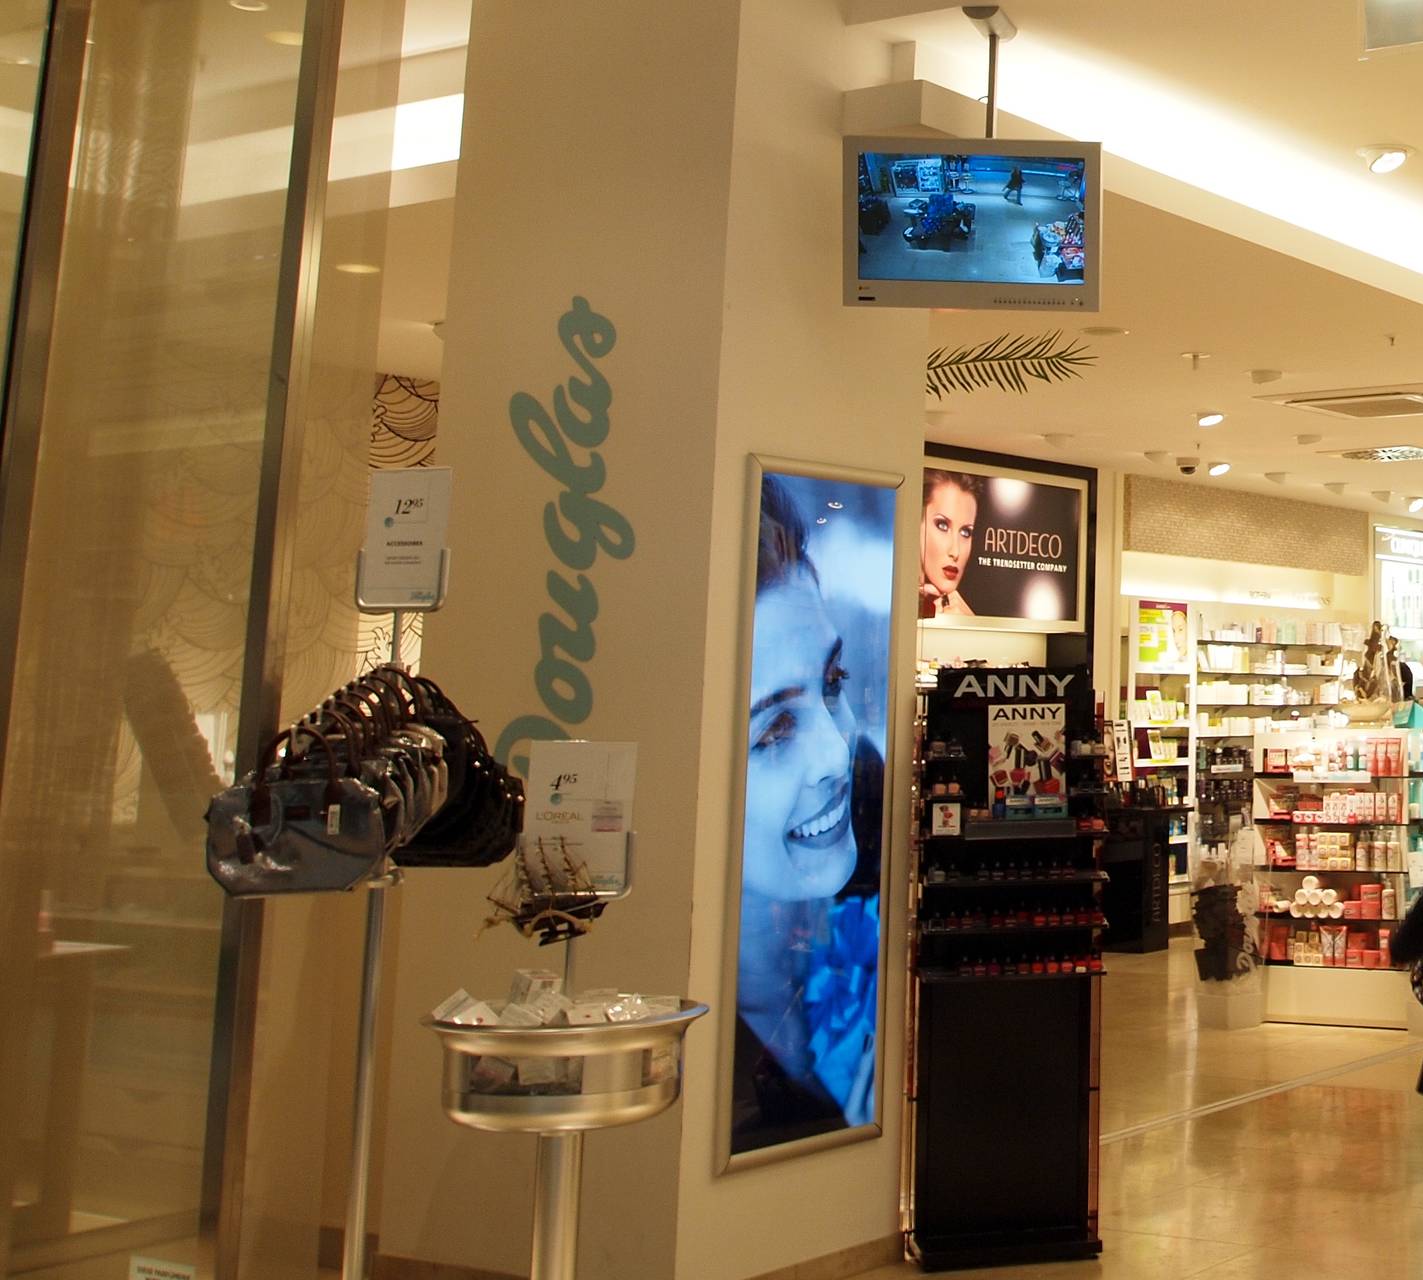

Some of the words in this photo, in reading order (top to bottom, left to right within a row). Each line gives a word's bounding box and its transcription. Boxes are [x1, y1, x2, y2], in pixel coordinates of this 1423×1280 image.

[984, 527, 1062, 559] ARTDECO
[978, 556, 991, 567] THE
[992, 558, 1036, 571] TRENDSETTER
[1036, 562, 1067, 573] COMPANY
[953, 674, 1075, 698] ANNY
[992, 706, 1062, 721] ANNY
